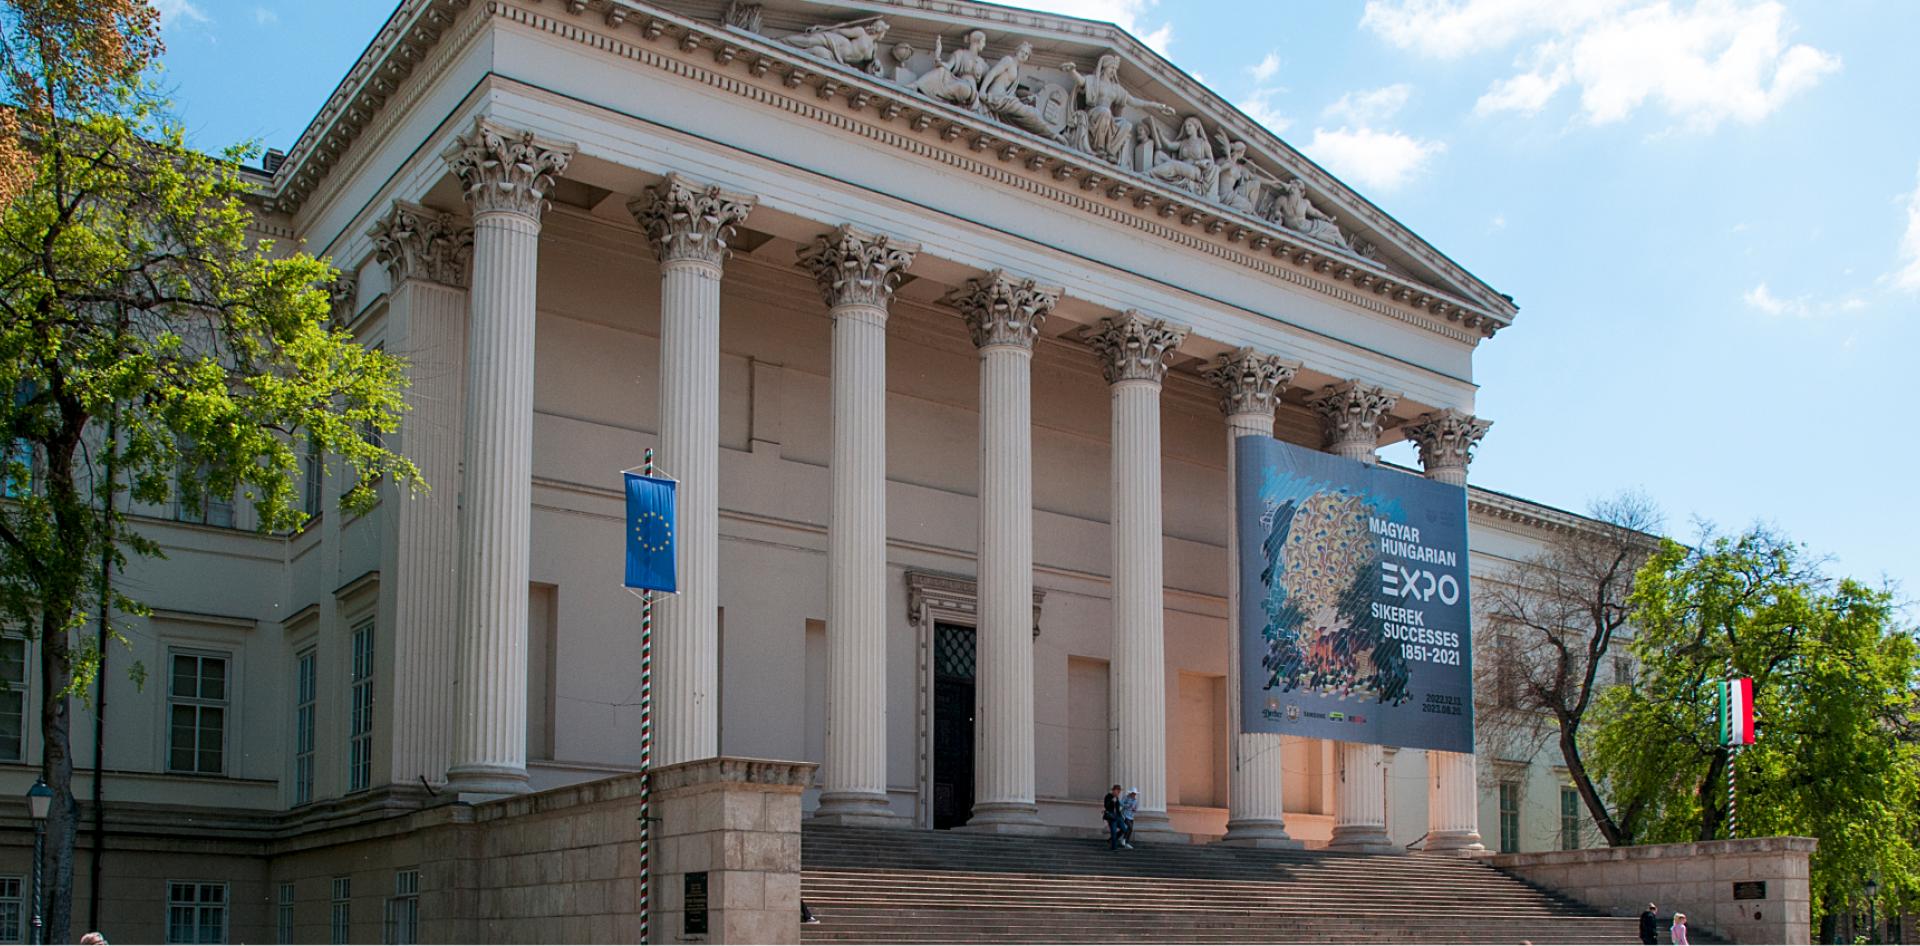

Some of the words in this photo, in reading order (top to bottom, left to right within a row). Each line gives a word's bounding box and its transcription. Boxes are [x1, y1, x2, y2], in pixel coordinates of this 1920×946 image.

[1368, 517, 1420, 543] MAGYAR
[1381, 537, 1456, 567] HUNGARIAN
[1382, 562, 1459, 606] EXPO
[1371, 602, 1424, 626] SIKEREK
[1383, 622, 1460, 648] SUCCESSES
[1401, 643, 1460, 666] 1851-2021
